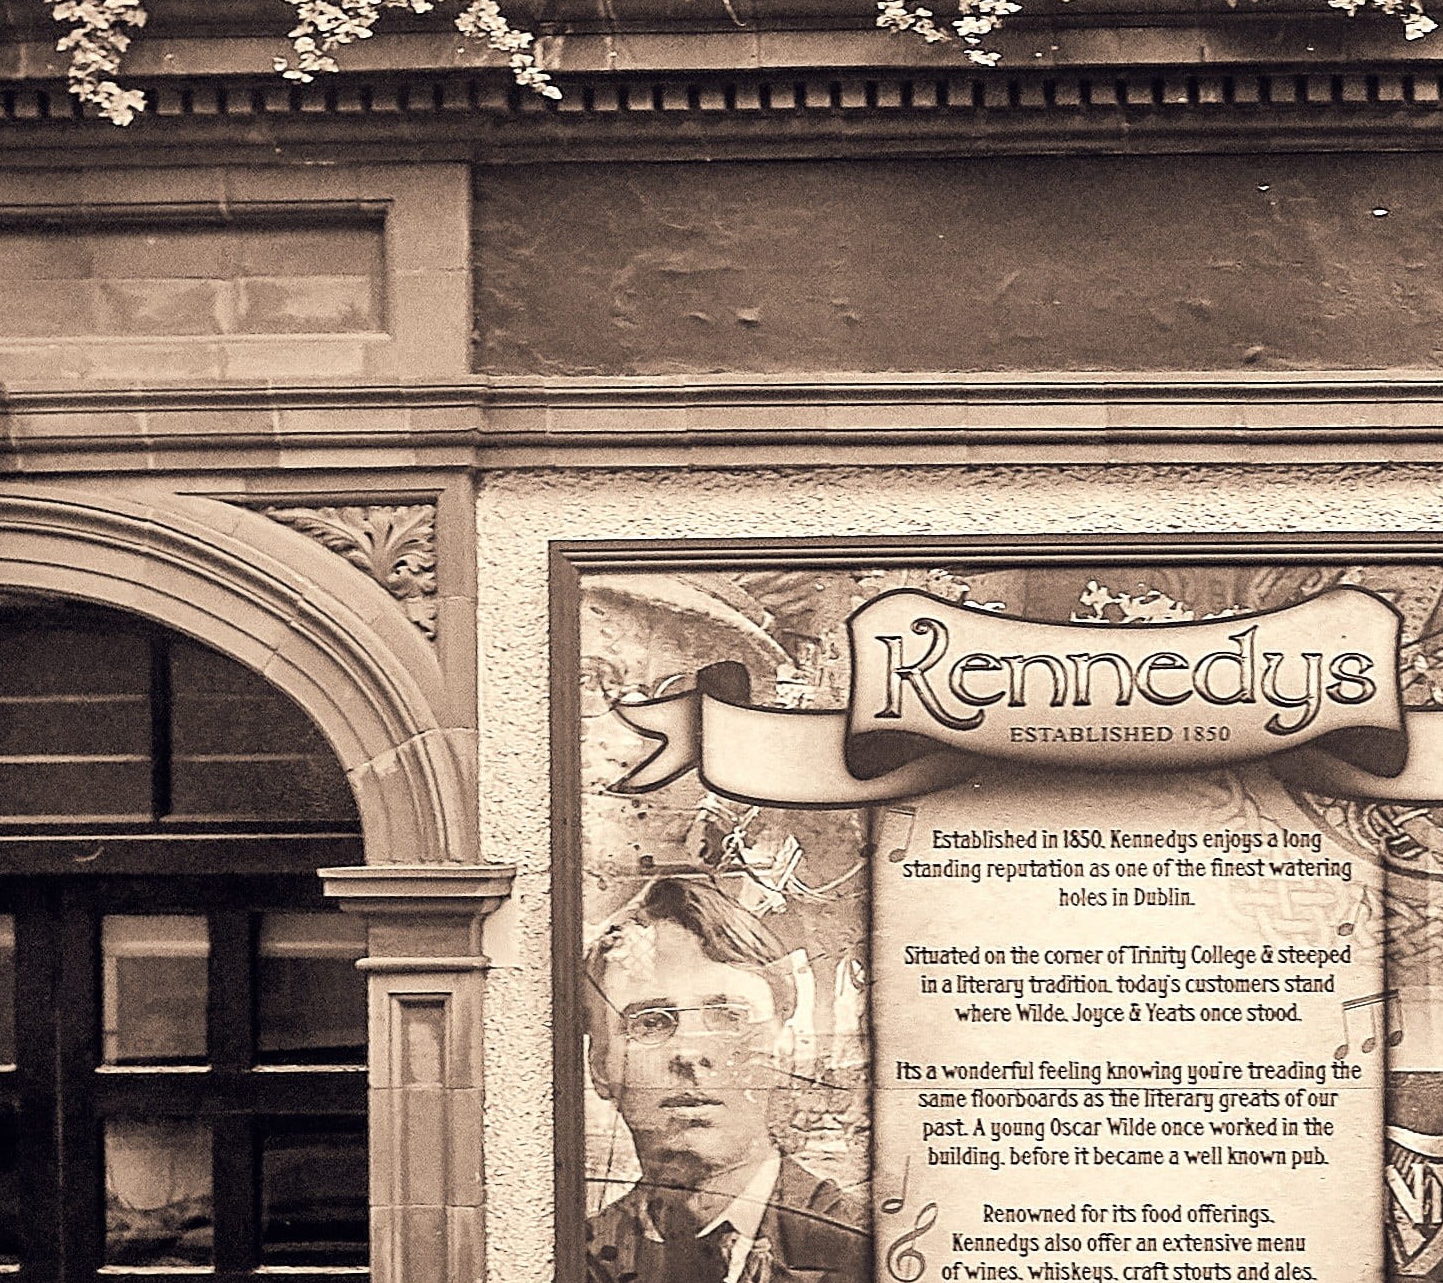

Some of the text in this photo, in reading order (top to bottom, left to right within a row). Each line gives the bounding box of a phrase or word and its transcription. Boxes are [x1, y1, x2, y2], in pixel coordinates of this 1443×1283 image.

[876, 615, 1378, 735] Kennedys
[1009, 723, 1232, 745] ESTABLISHED 1850
[932, 827, 1322, 854] Established in Kennedys enjoys a long
[899, 857, 1352, 884] standing reputation as one of the finest watering
[1059, 887, 1108, 907] holes
[1112, 887, 1128, 907] in
[904, 944, 1351, 970] Situated on the corner of Trinity College & steeped
[920, 974, 938, 994] in
[941, 978, 952, 994] a
[956, 974, 1024, 999] literary
[1185, 974, 1280, 993] customers
[1284, 973, 1335, 993] stand
[954, 1003, 1012, 1023] where
[1072, 1002, 1125, 1028] Joyce
[1129, 1002, 1142, 1022] &
[1145, 1002, 1196, 1022] Yeats
[1200, 1007, 1242, 1022] once
[925, 1065, 937, 1080] a
[940, 1060, 1034, 1080] wonderful
[1038, 1060, 1101, 1086] feeling
[1106, 1060, 1182, 1085] knowing
[1246, 1060, 1326, 1085] treading
[1330, 1060, 1362, 1080] the
[918, 1088, 1339, 1113] same floorboards as the literary greats of our
[972, 1118, 986, 1137] A
[990, 1122, 1045, 1142] young
[1050, 1117, 1102, 1137] Oscar
[1106, 1117, 1157, 1137] Wilde
[1161, 1121, 1204, 1136] once
[1208, 1117, 1278, 1136] worked
[1281, 1117, 1298, 1136] in
[1303, 1116, 1334, 1136] the
[1009, 1146, 1069, 1166] before
[1074, 1146, 1090, 1165] it
[1093, 1146, 1164, 1166] became
[1168, 1150, 1179, 1165] a
[1183, 1146, 1223, 1165] well
[1227, 1146, 1287, 1165] known
[983, 1203, 1182, 1223] Renowned for its food
[952, 1232, 1306, 1258] Kennedys also offer an extensive menu
[941, 1261, 964, 1281] of
[1123, 1261, 1170, 1281] craft
[1173, 1262, 1232, 1281] stouts
[1237, 1261, 1270, 1281] and
